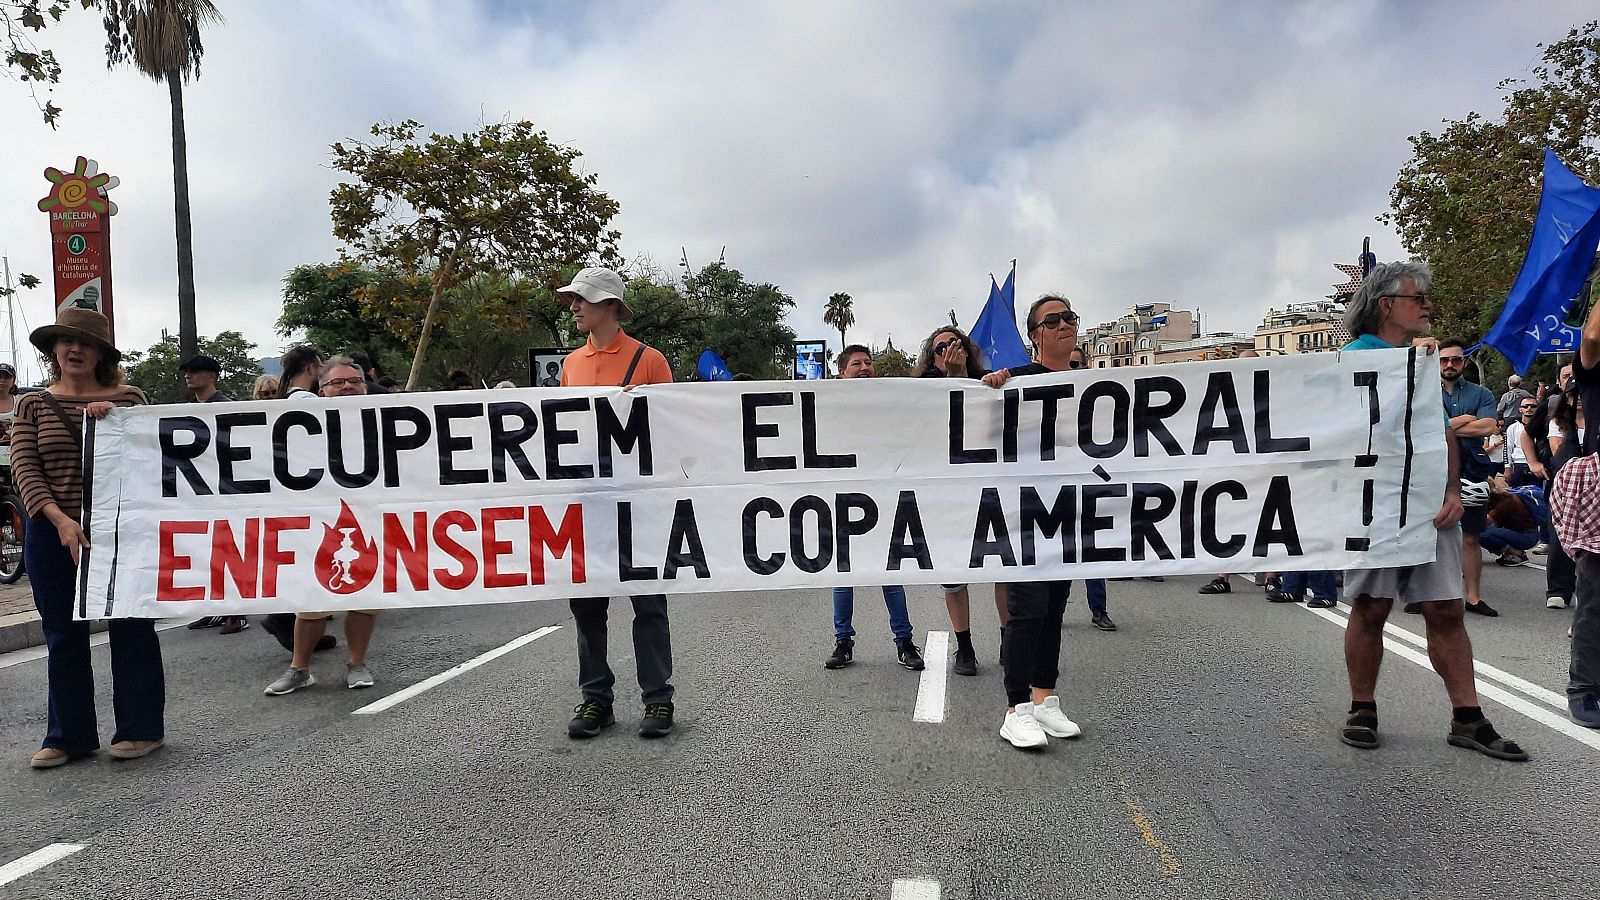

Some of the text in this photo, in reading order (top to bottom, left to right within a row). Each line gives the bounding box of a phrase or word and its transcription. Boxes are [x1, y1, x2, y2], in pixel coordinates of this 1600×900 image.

[72, 238, 79, 250] 4
[159, 395, 653, 497] RECUPEREM
[741, 391, 858, 473] EL
[948, 369, 1311, 465] LITORAL
[617, 499, 712, 583] LA
[741, 490, 934, 576] COPA
[968, 463, 1304, 570] AMÈRICA
